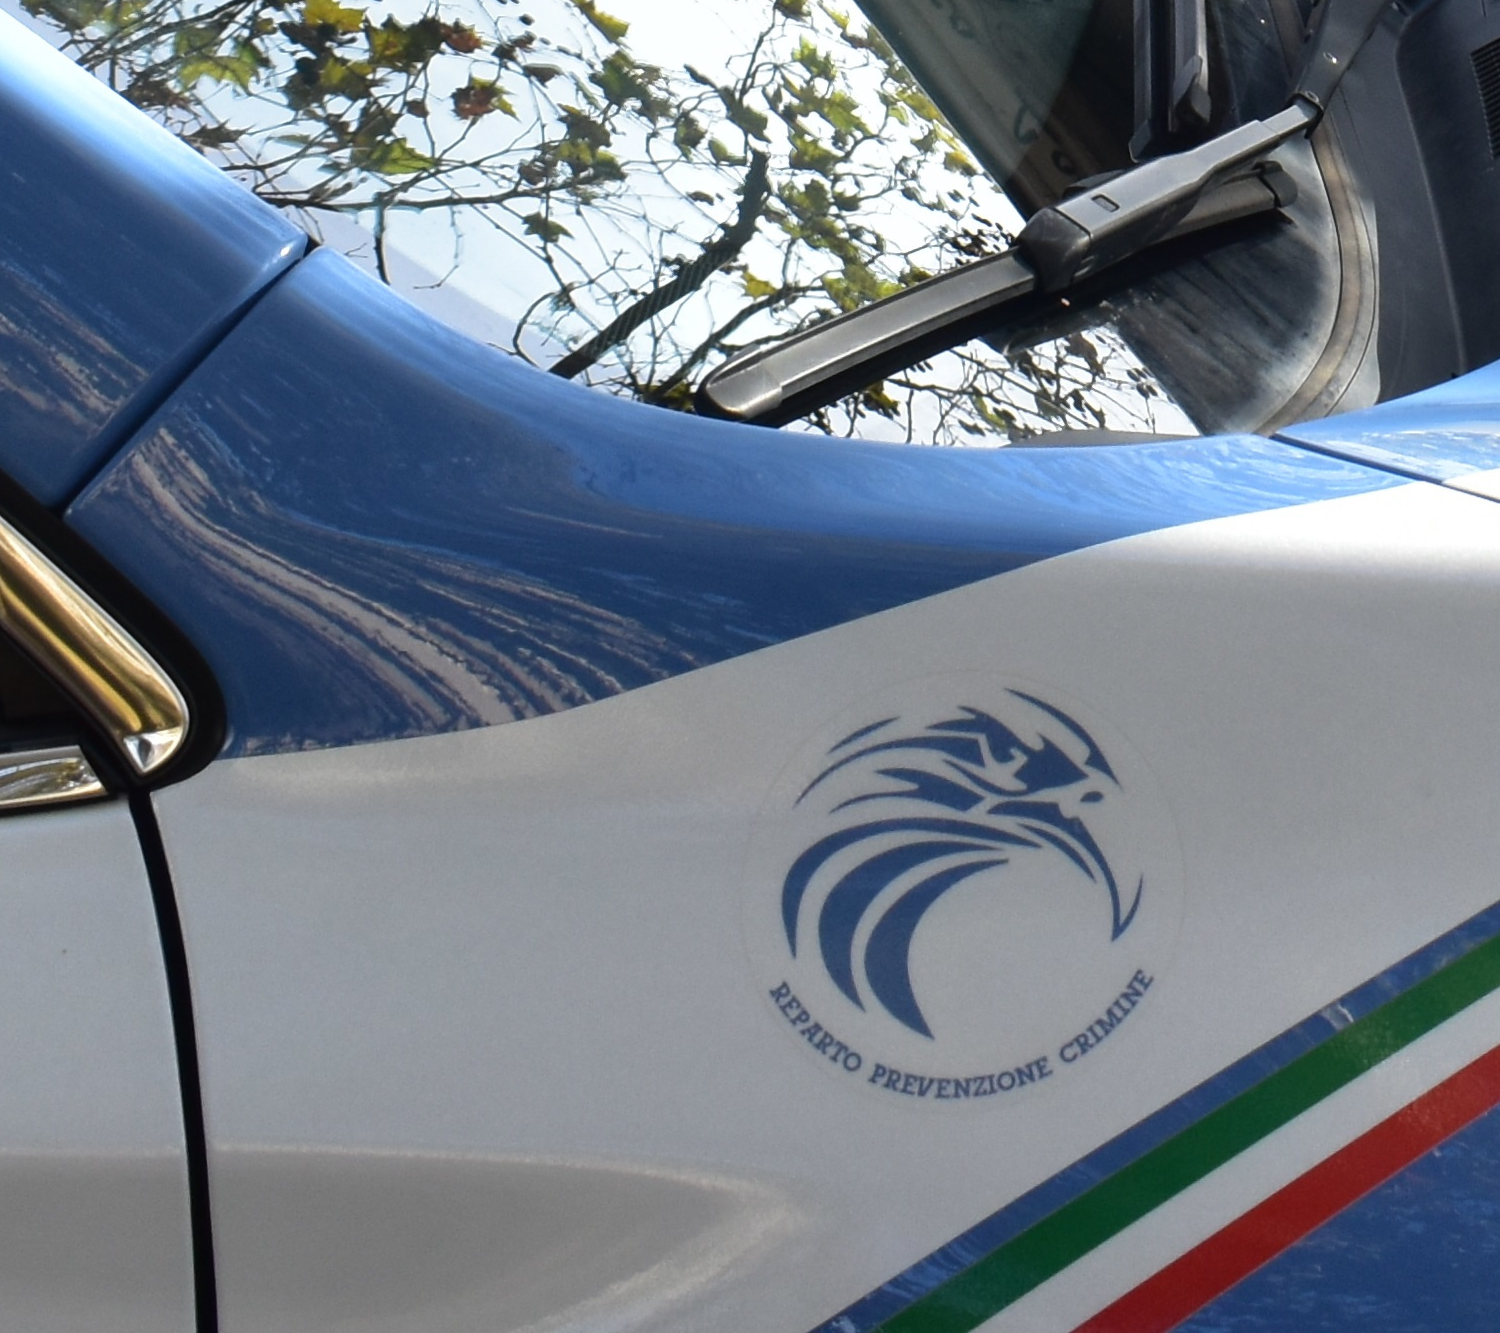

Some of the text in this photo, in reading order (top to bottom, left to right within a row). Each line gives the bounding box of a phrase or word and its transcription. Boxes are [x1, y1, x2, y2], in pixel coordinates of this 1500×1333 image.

[769, 968, 1155, 1100] REPARTO PREVENZIONE CRIMINE
